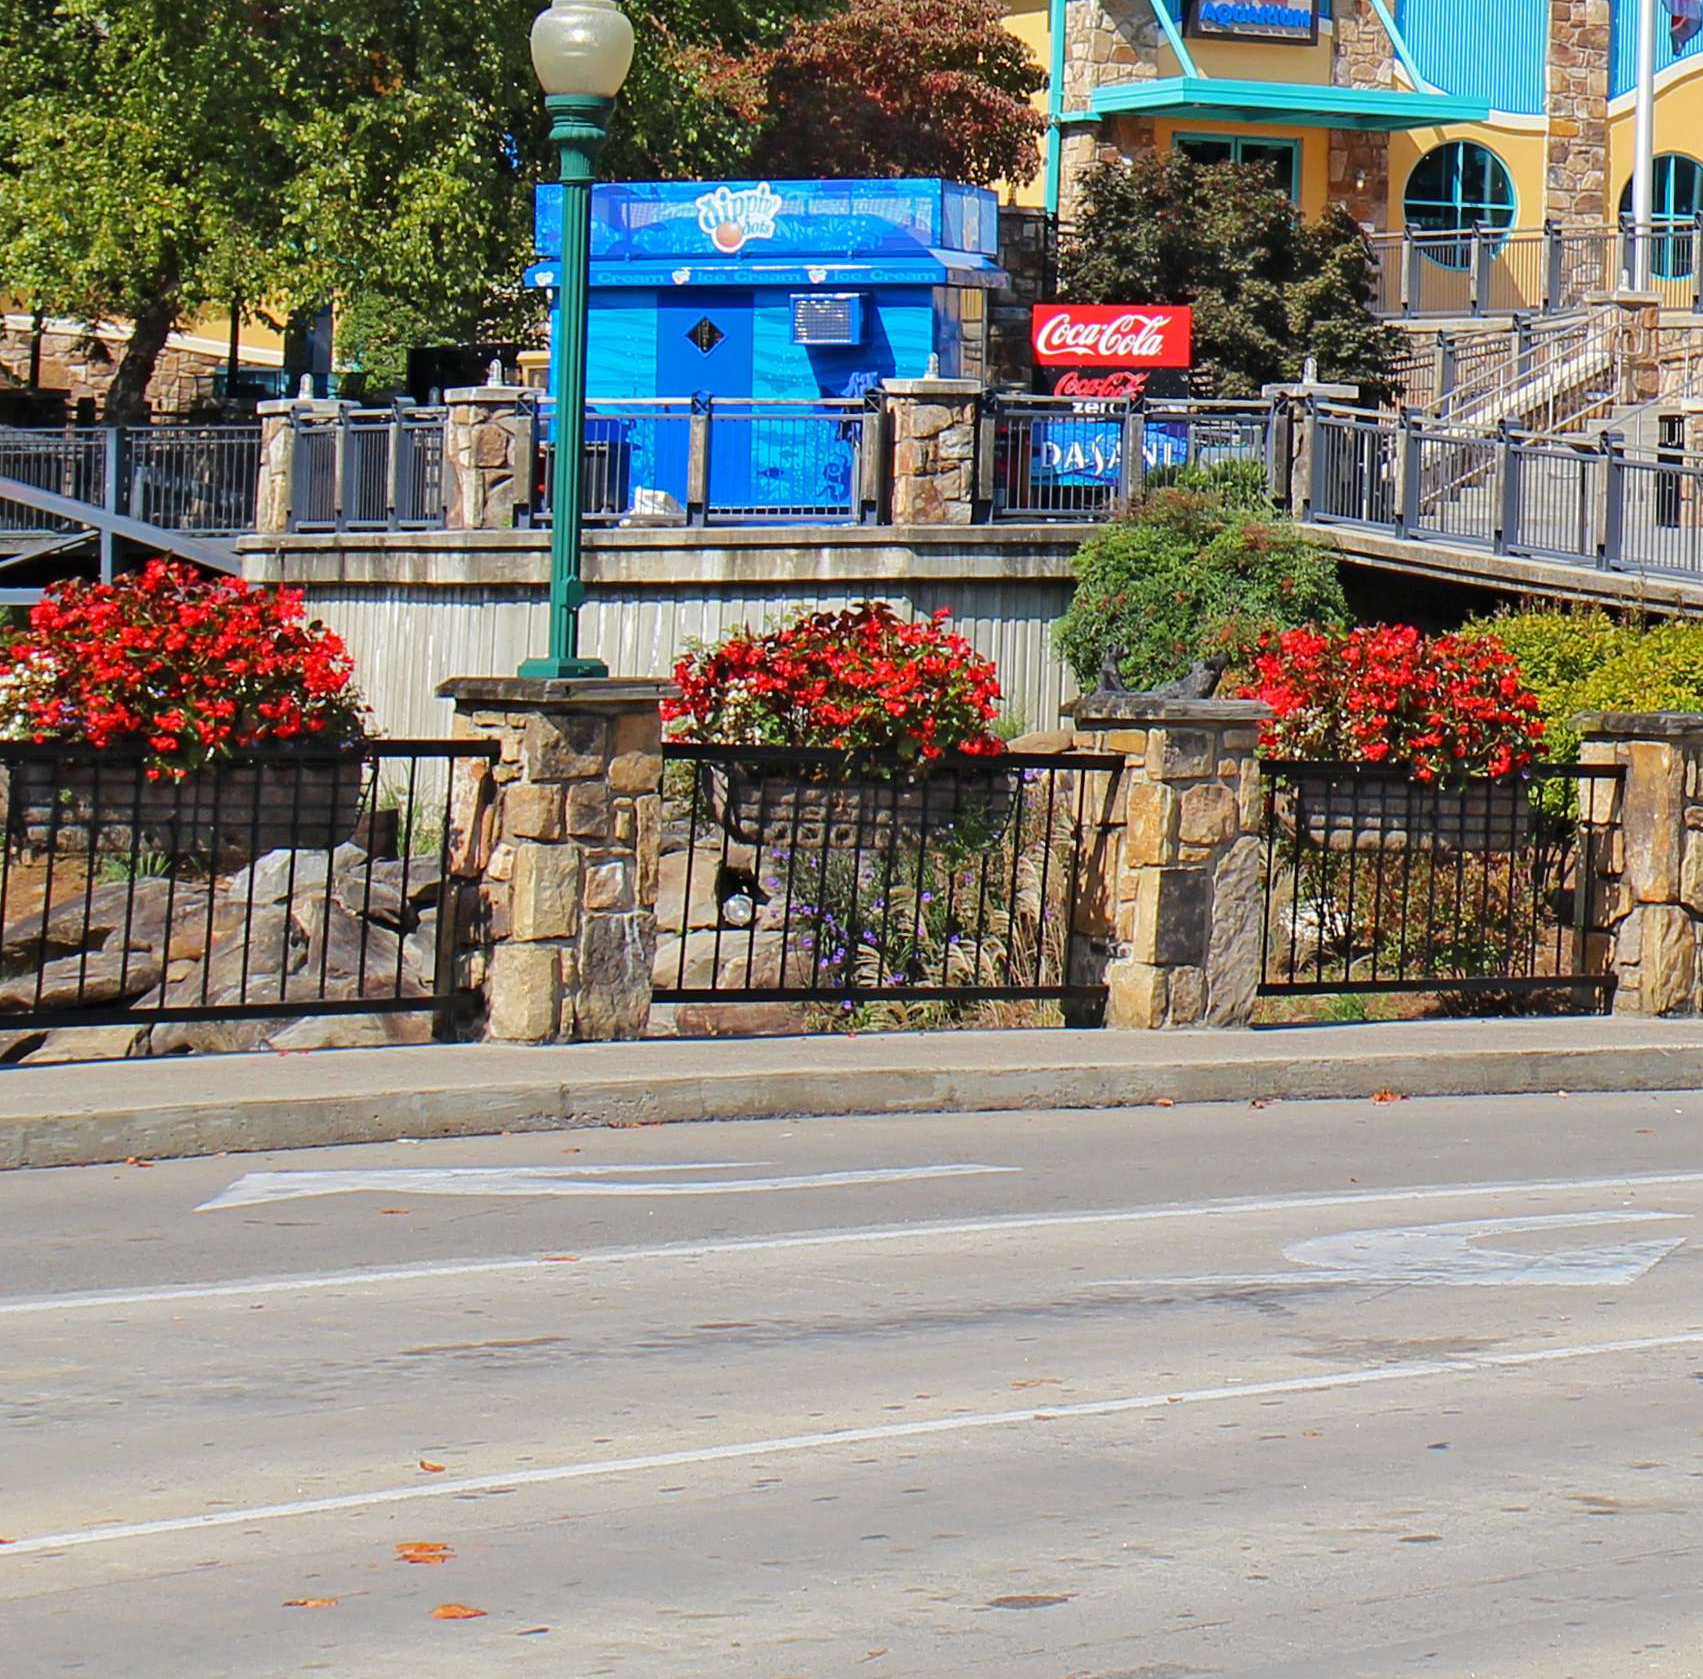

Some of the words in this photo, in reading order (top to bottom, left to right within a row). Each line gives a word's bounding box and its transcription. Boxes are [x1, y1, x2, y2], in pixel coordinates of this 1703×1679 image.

[1200, 2, 1312, 27] AQUARIUM
[597, 273, 664, 283] Cream
[698, 273, 725, 282] Ice
[734, 272, 799, 283] Cream
[834, 271, 862, 281] Ice
[870, 269, 936, 281] Cream
[1037, 313, 1172, 356] Coca-Cola
